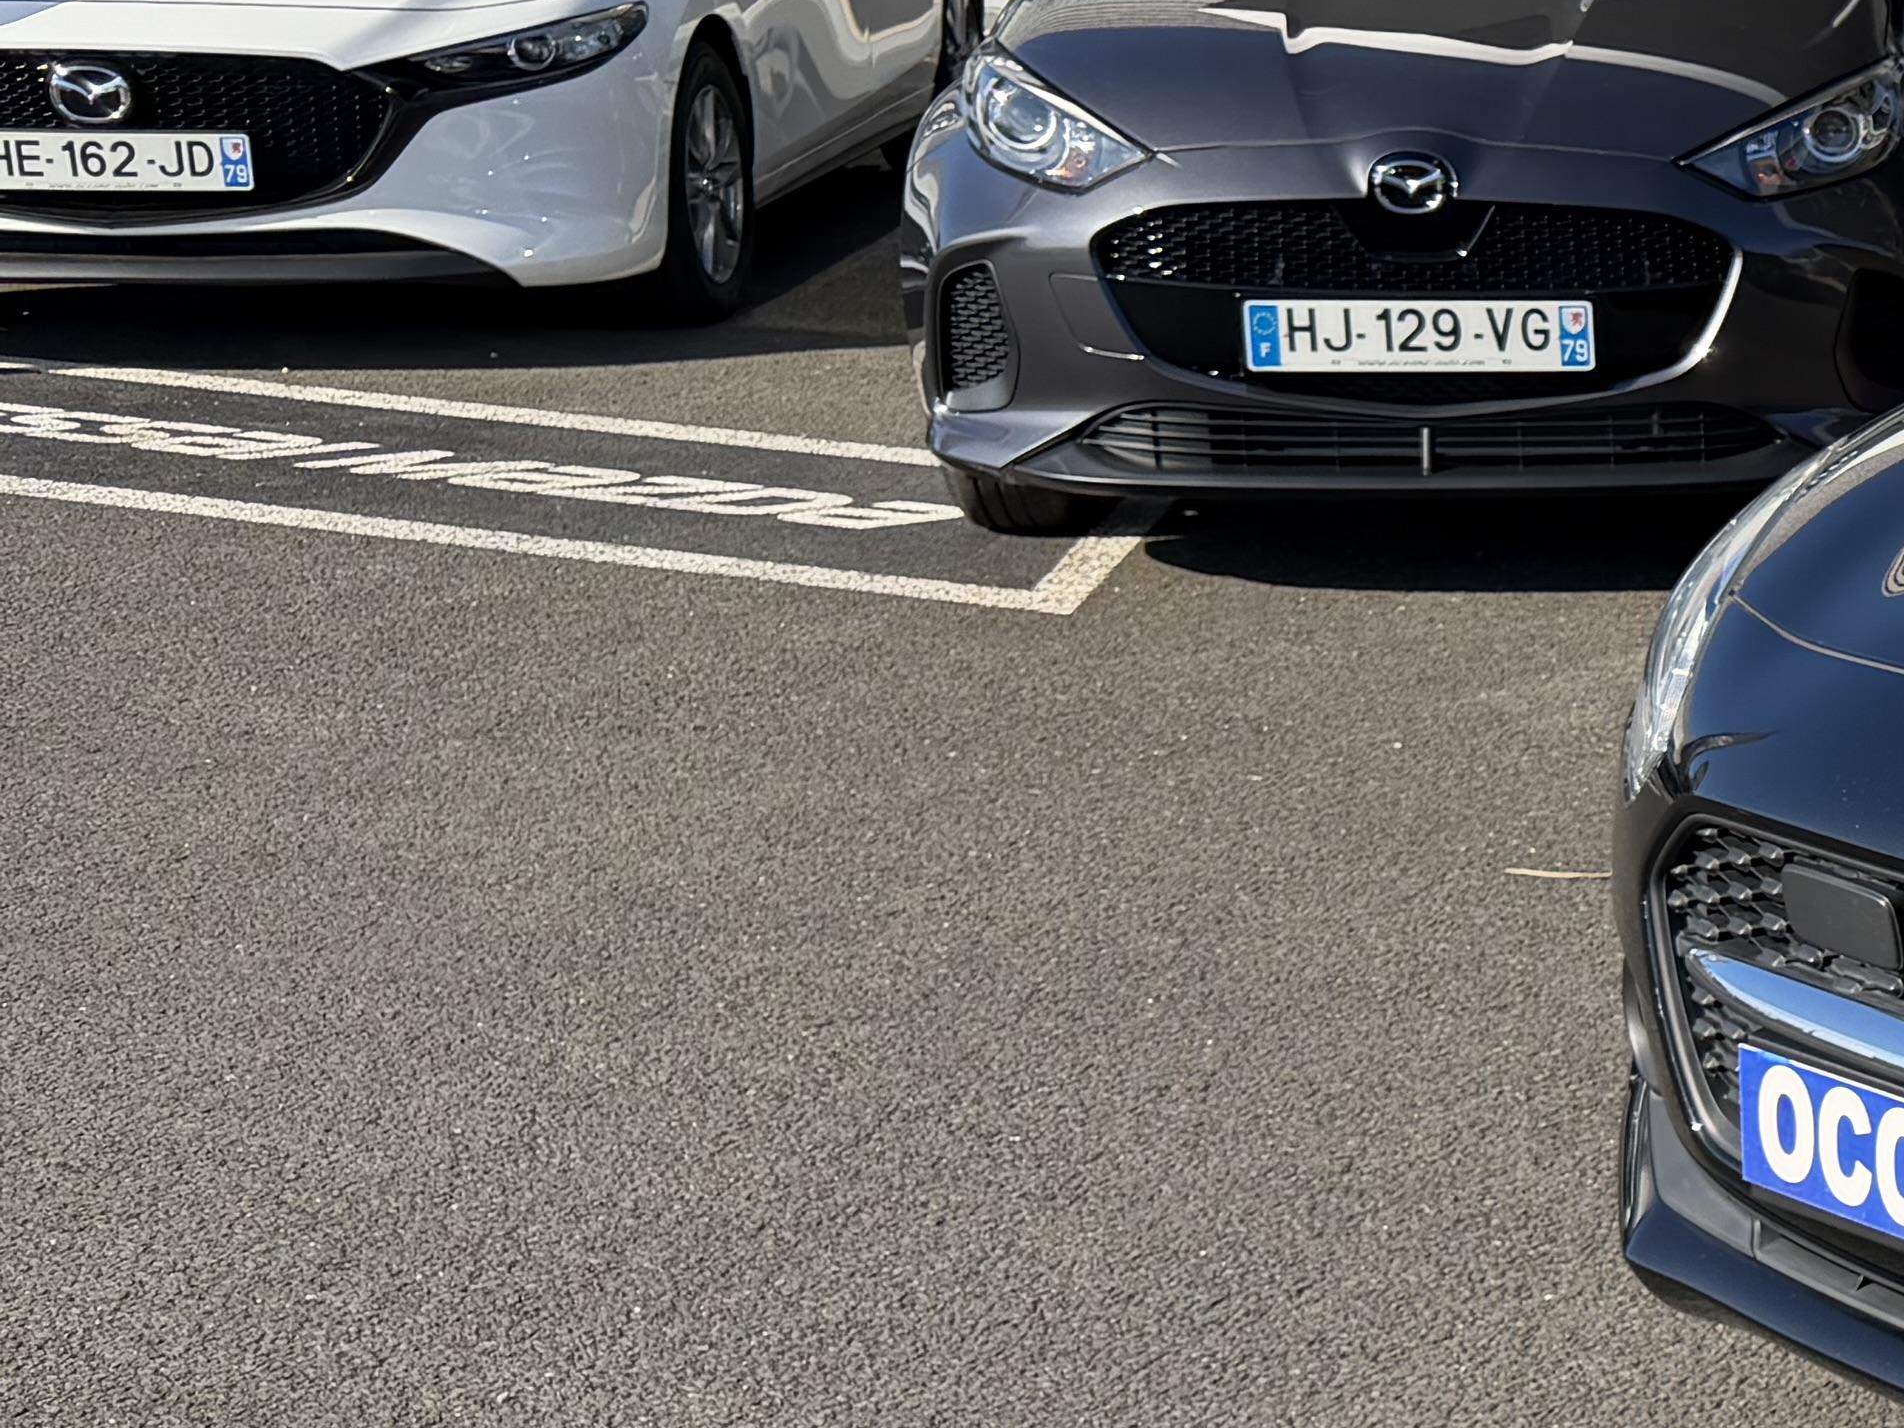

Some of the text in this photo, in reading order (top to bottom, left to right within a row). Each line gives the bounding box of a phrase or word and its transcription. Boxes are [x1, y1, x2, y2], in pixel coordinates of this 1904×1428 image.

[224, 164, 248, 184] 79
[1285, 307, 1551, 353] HJ-129-VG
[1259, 342, 1272, 359] F
[1562, 338, 1589, 362] 79
